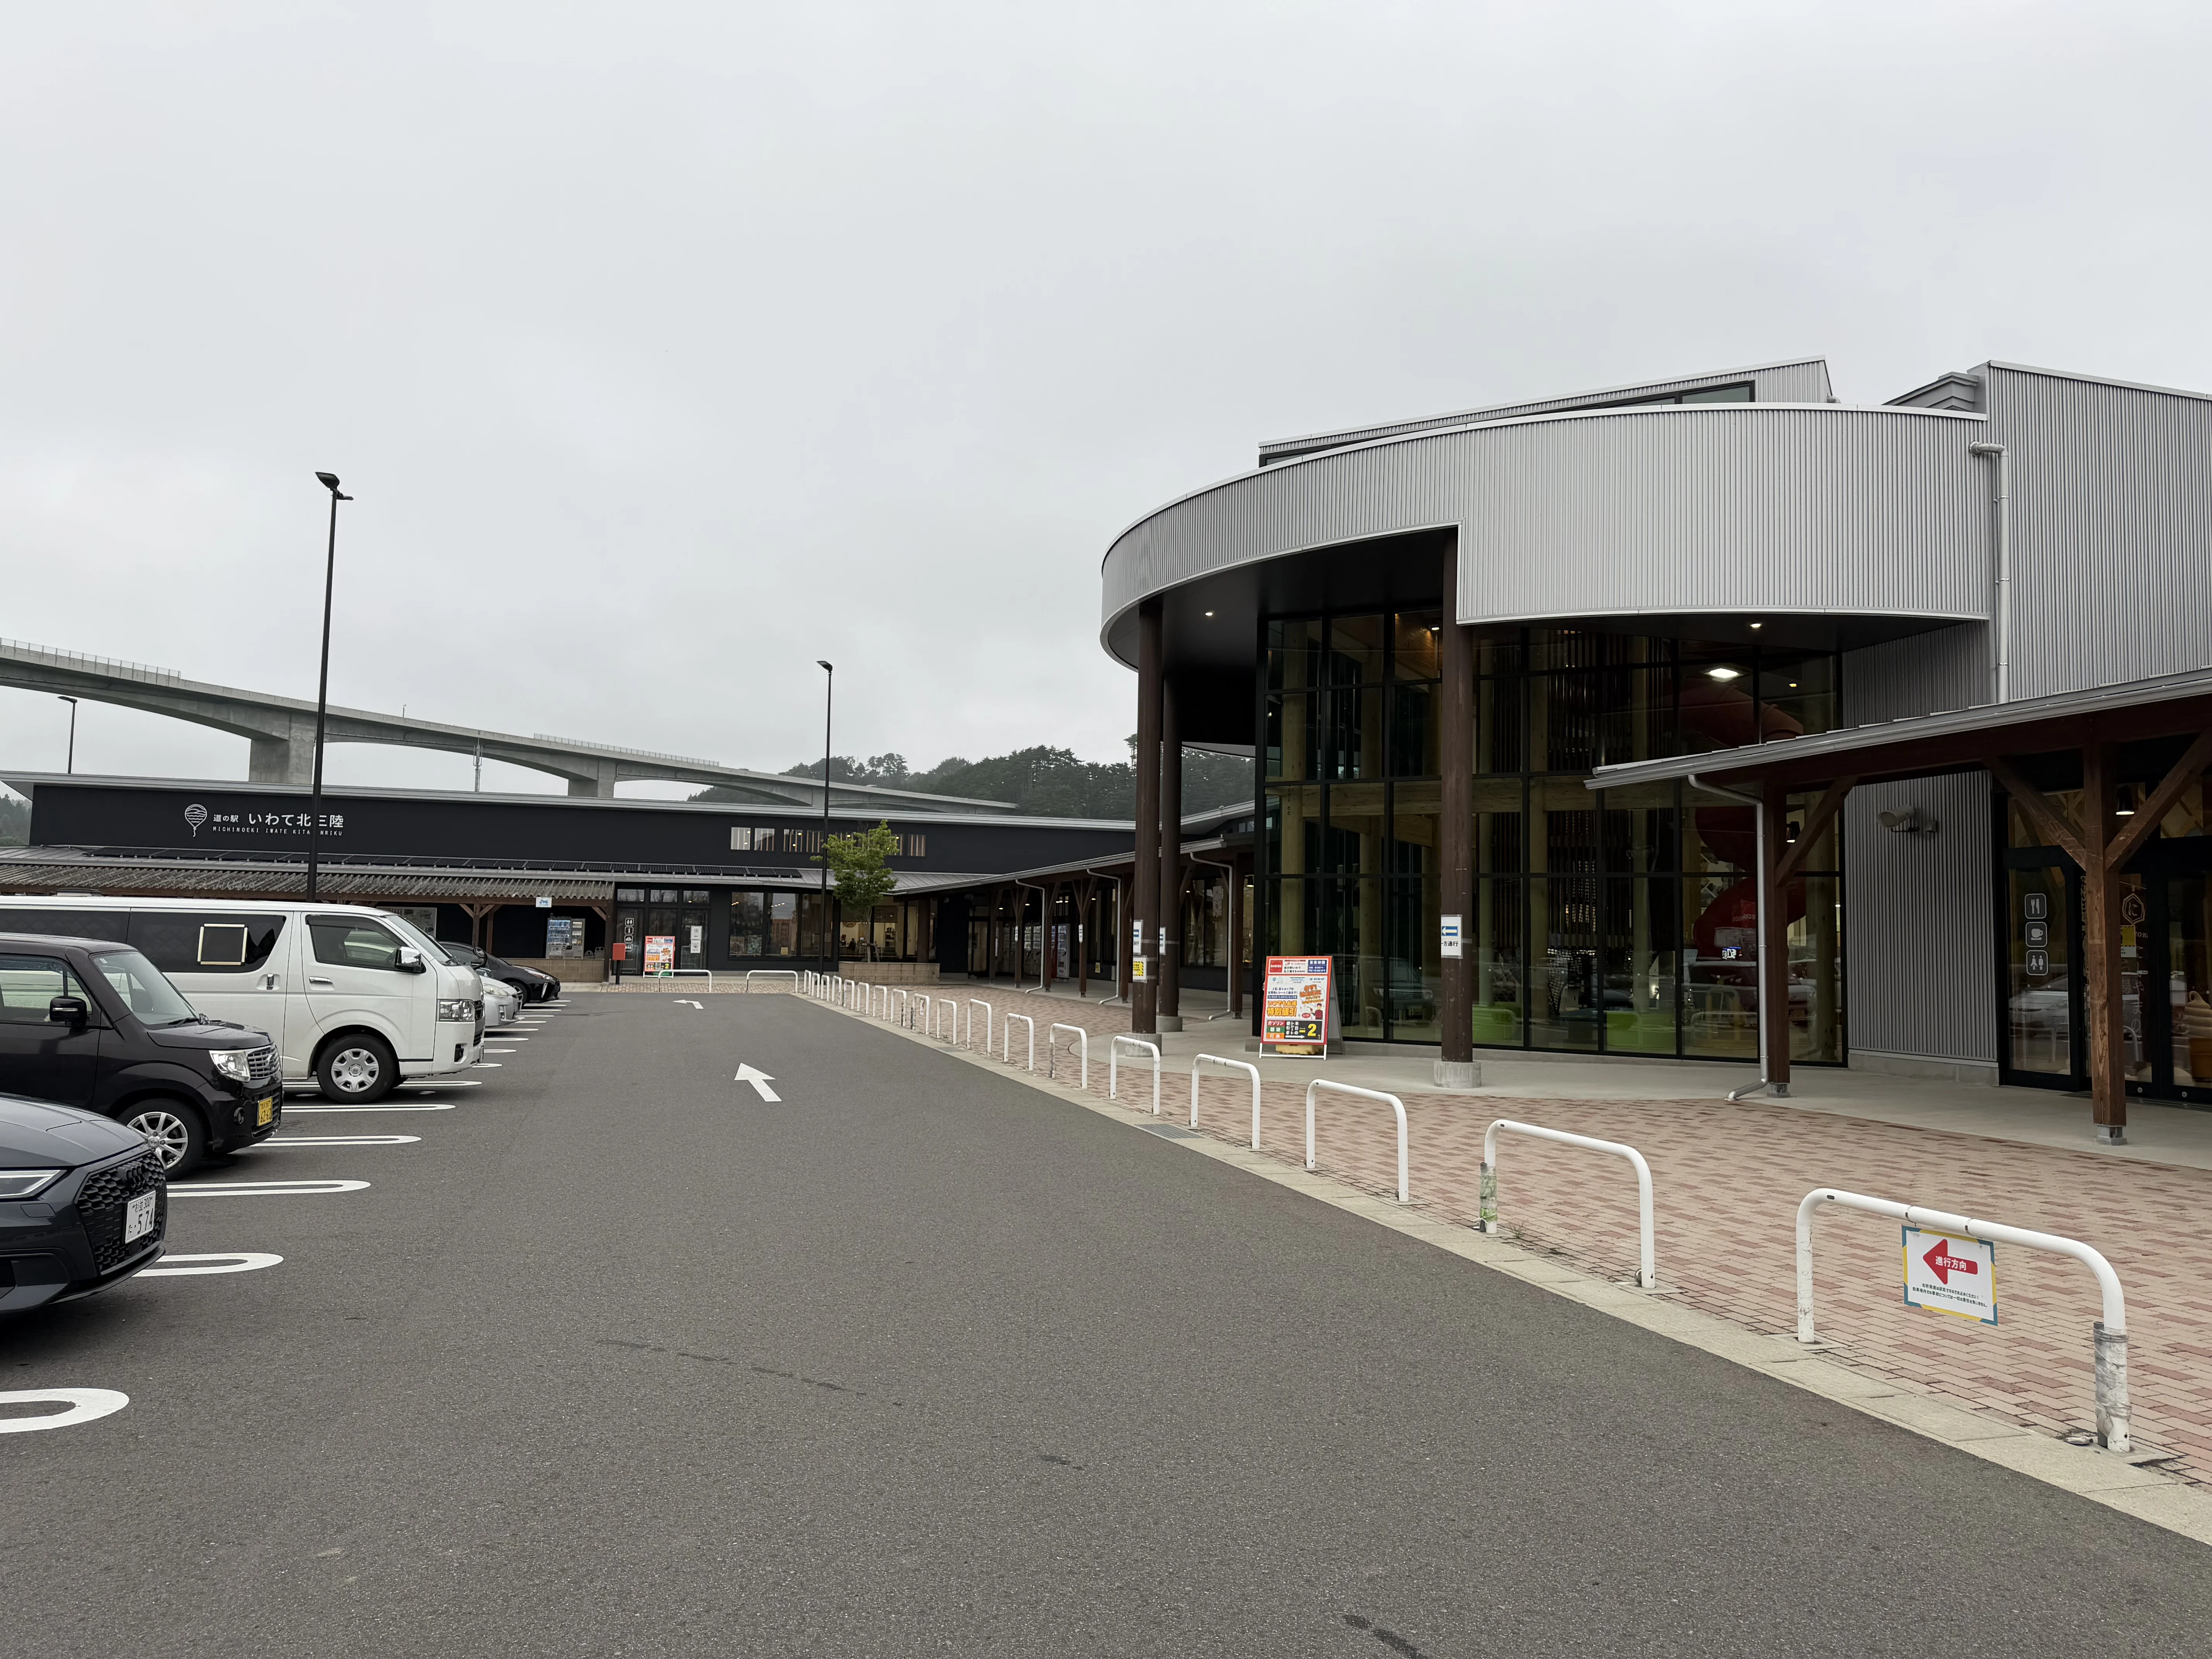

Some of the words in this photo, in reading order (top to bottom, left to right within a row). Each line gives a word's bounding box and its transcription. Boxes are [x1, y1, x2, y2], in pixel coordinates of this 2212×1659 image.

[213, 814, 239, 823] 道の駅
[1267, 1006, 1297, 1017] 特別値引
[1307, 1024, 1317, 1037] 2
[1935, 1255, 1966, 1271] 進行方向
